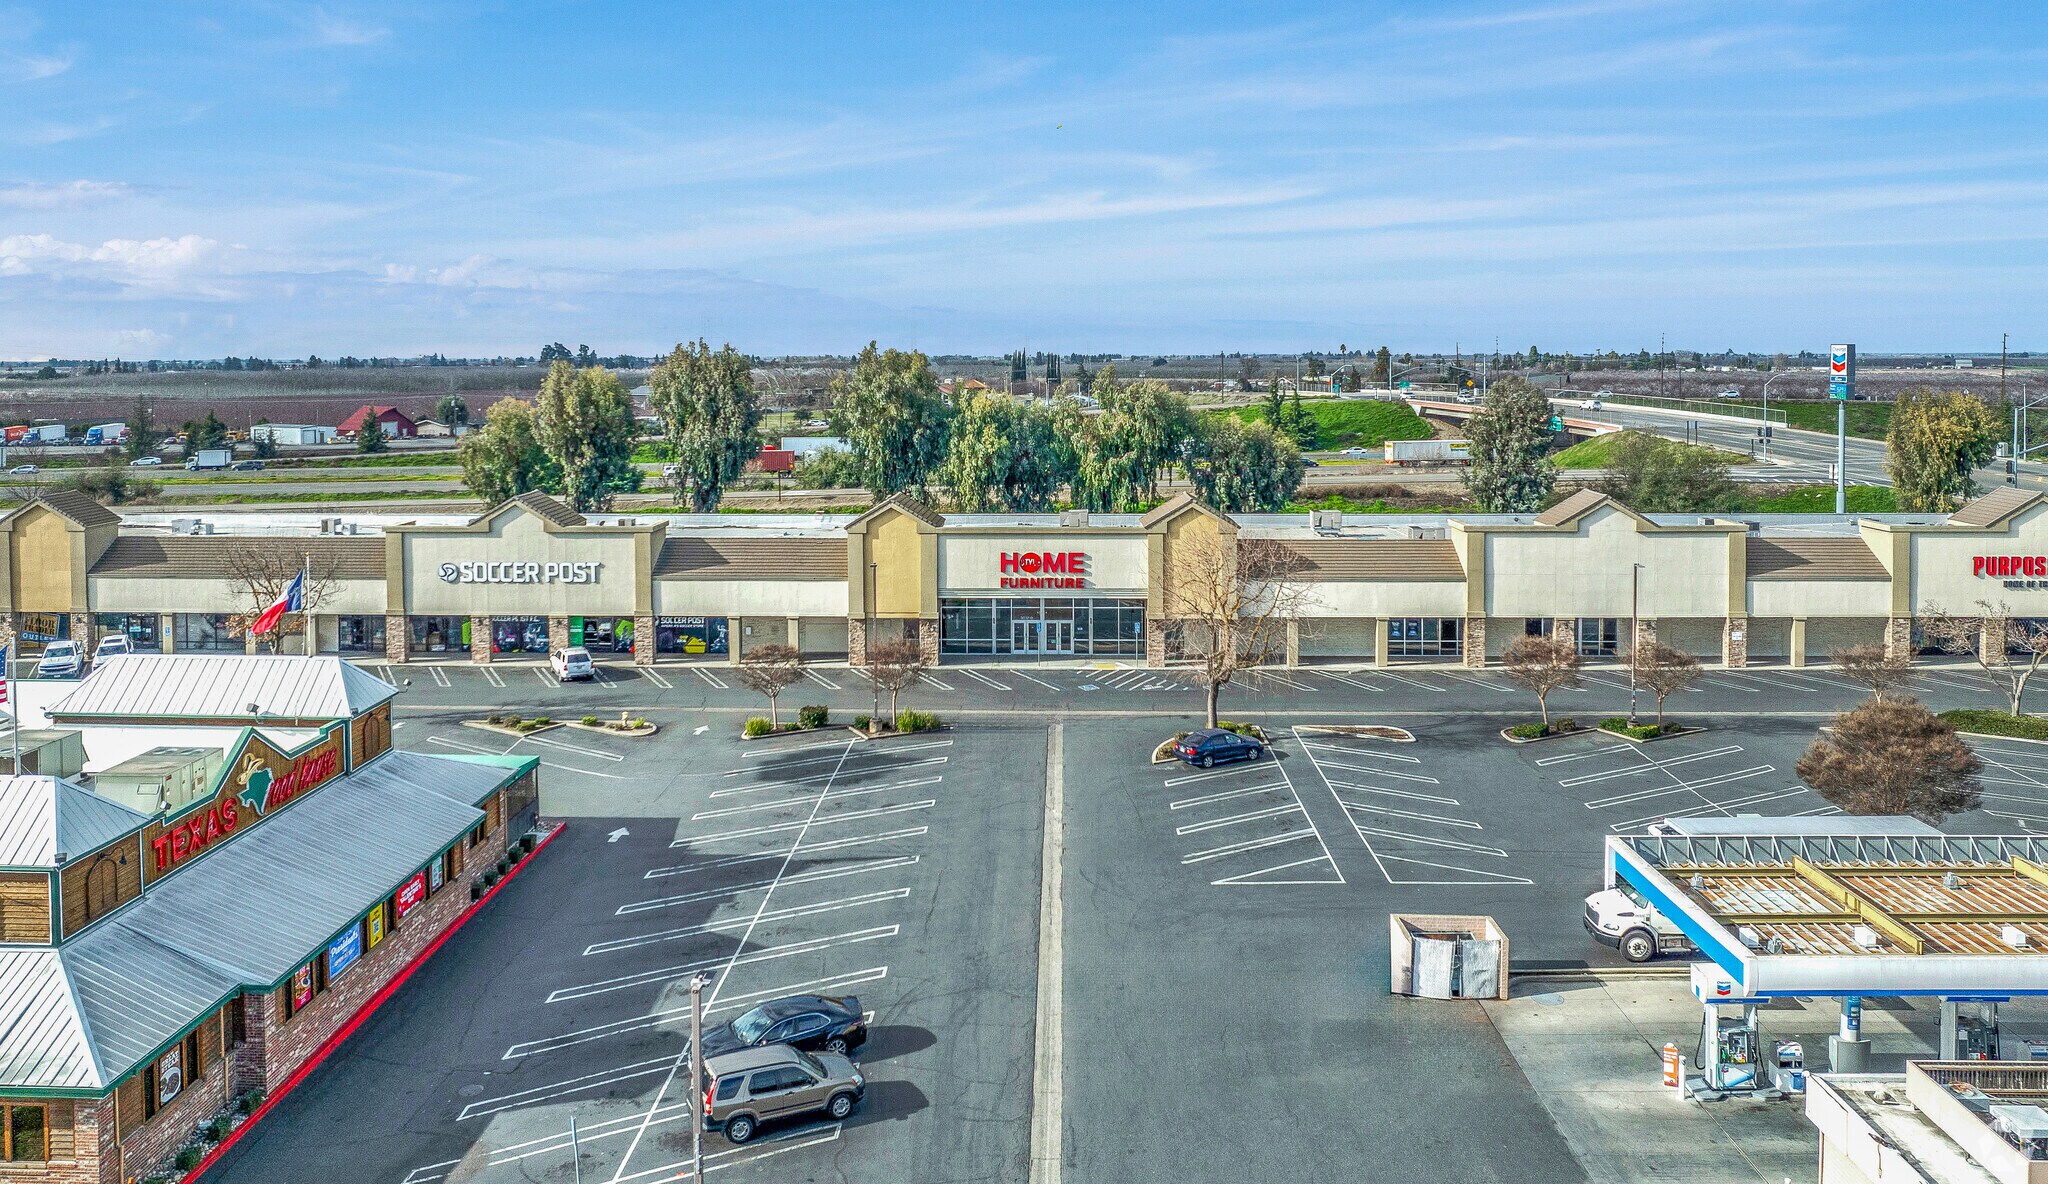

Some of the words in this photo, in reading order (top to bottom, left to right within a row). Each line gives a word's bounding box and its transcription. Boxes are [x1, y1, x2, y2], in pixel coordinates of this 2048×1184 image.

[1000, 552, 1085, 573] HOME
[459, 562, 540, 583] SOCCER
[544, 562, 601, 583] POST
[1000, 577, 1085, 589] FURNITURE
[2003, 580, 2025, 588] HOME
[2026, 580, 2037, 588] OF
[24, 616, 56, 628] FLOOR
[661, 616, 687, 624] SOCCER
[687, 616, 705, 624] POST
[24, 624, 56, 635] TRADER
[22, 632, 54, 641] OUTLET
[152, 798, 238, 870] TEXAS
